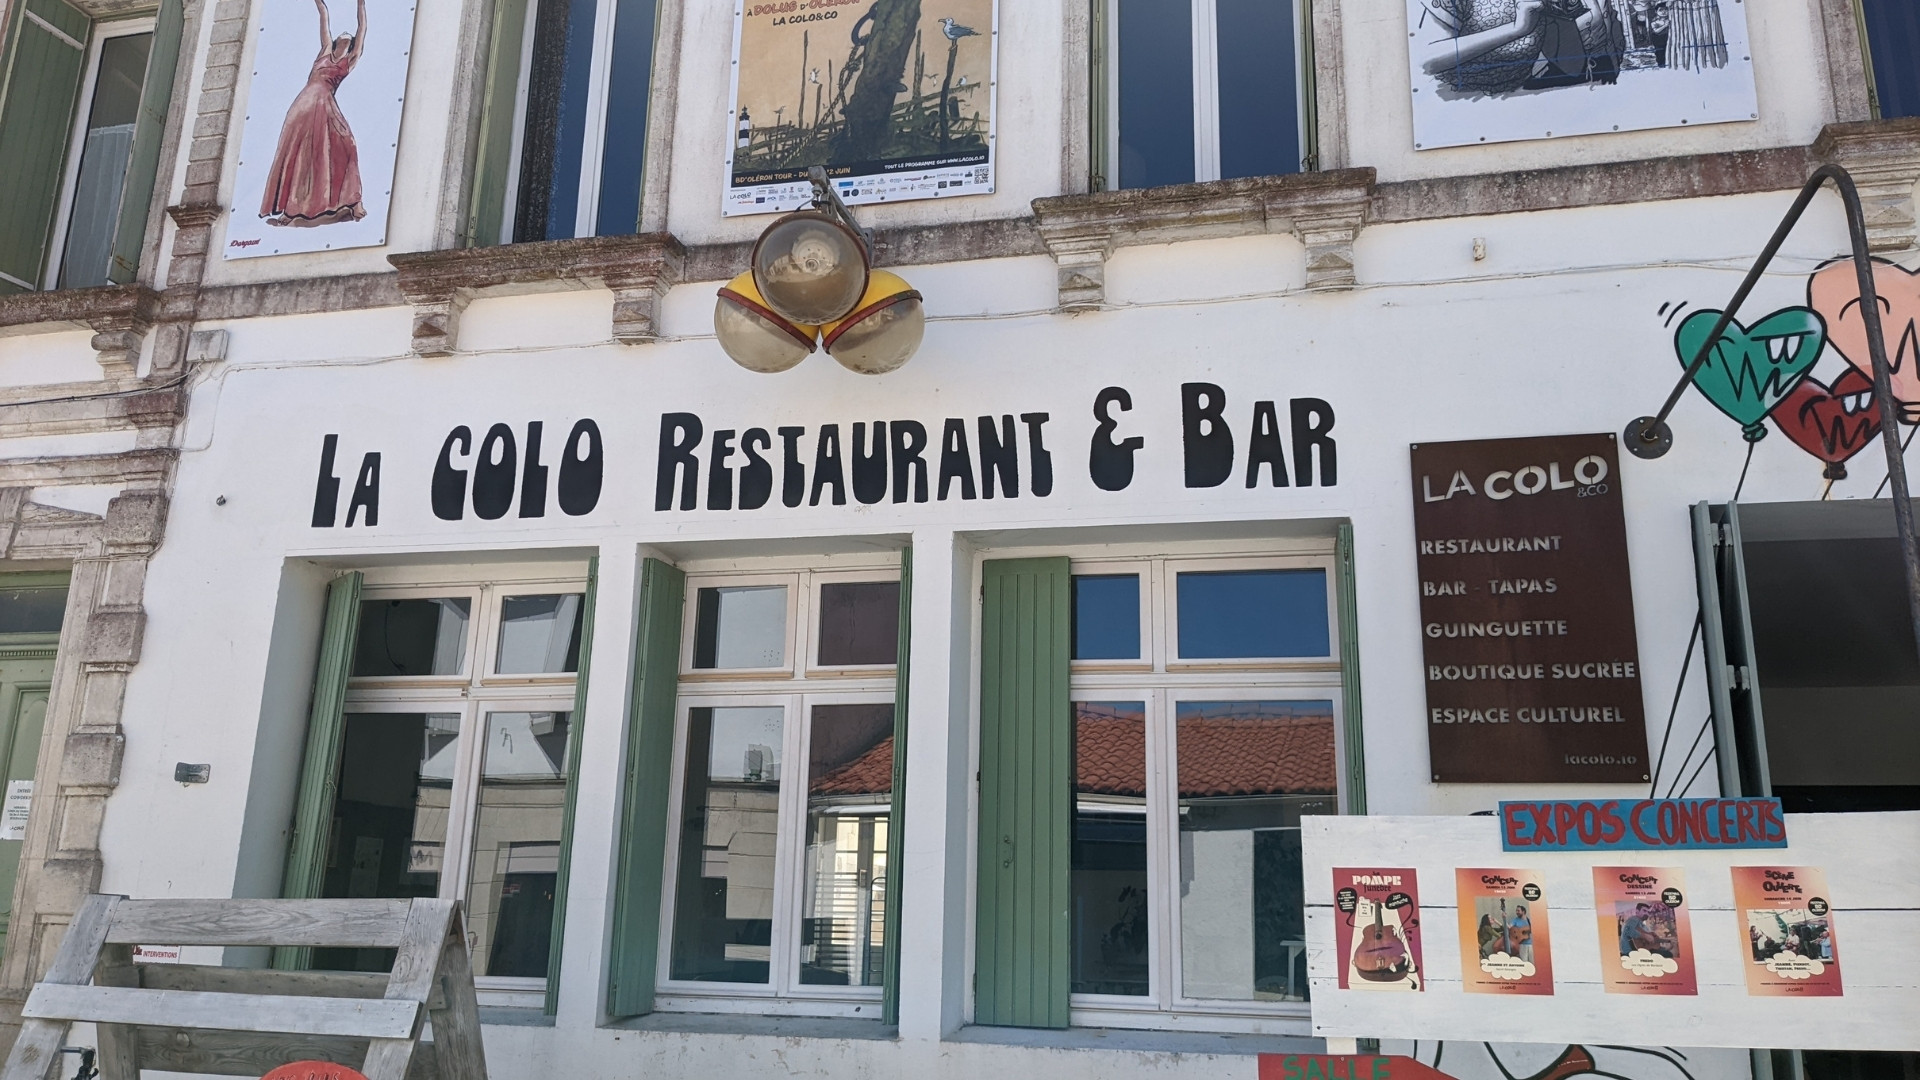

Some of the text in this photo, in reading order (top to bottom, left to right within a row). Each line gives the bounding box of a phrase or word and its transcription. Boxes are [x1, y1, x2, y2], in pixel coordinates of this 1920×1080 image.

[754, 1, 797, 16] DOLUS
[800, 0, 860, 11] D'OLR
[773, 11, 838, 26] LA COLO&CO
[774, 172, 792, 180] TOUR
[311, 434, 381, 528] LA
[431, 418, 604, 521] COLO
[655, 412, 1053, 511] RESTAURANT
[1089, 386, 1144, 491] &
[1422, 454, 1608, 503] LA COLO
[1576, 483, 1609, 498] &CO
[1421, 535, 1562, 555] RESTAURANT
[1423, 580, 1467, 597] BAR
[1488, 577, 1558, 595] TAPAS
[1426, 620, 1568, 638] GUINGUETTE
[1429, 658, 1636, 681] BOUTIQUE SUCRÉE
[1432, 706, 1626, 724] ESPACE CULTUREL
[1504, 798, 1786, 846] EXPOS CONCERTS
[1352, 875, 1401, 886] POMPE
[1481, 875, 1518, 885] CONCERT
[1619, 874, 1658, 884] CONCERT
[1762, 881, 1803, 894] OUVERTE
[143, 950, 178, 958] INTERVENTIONS
